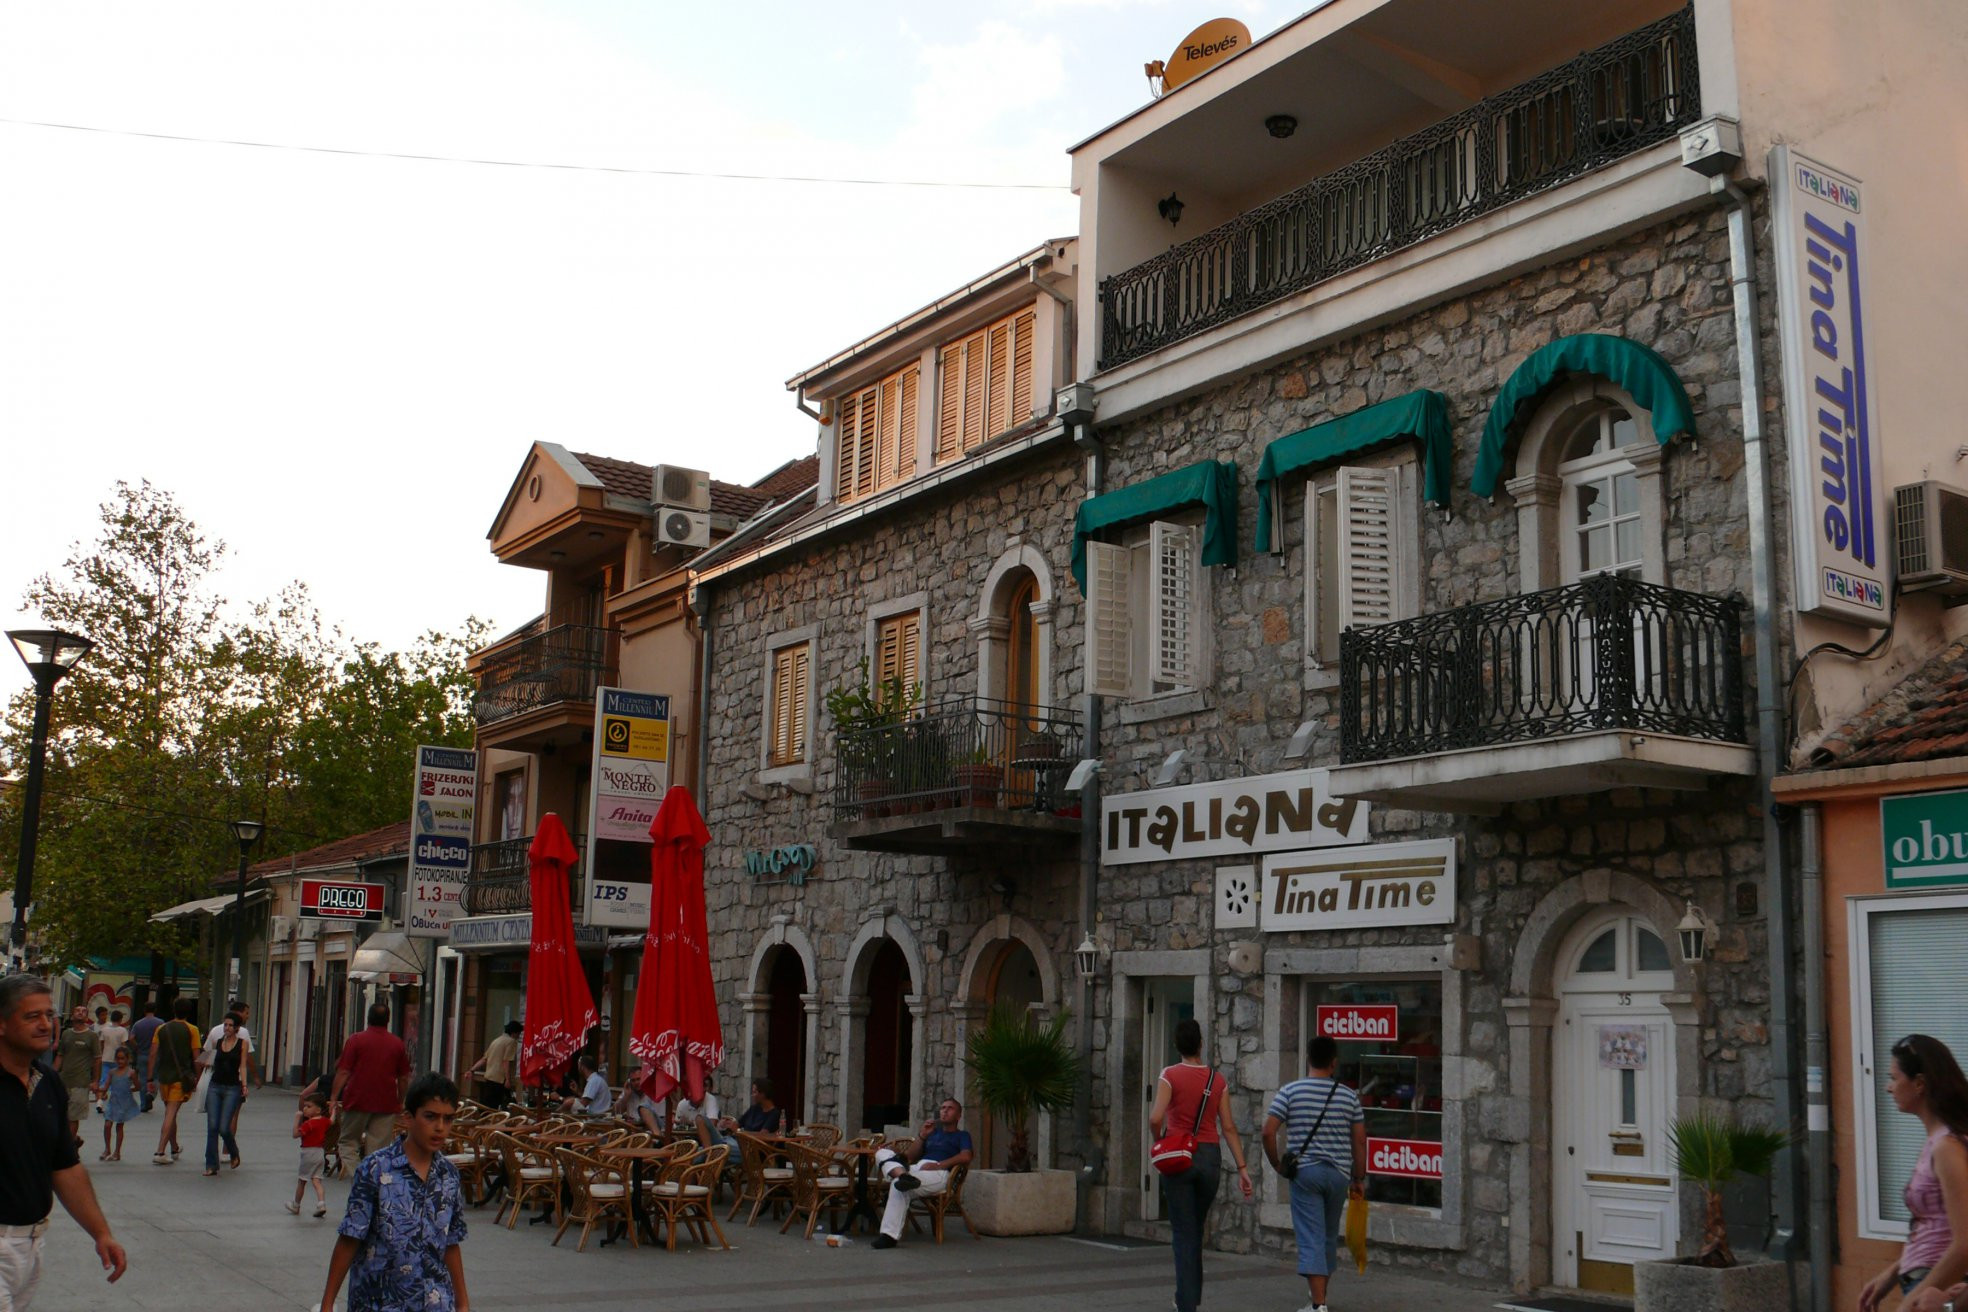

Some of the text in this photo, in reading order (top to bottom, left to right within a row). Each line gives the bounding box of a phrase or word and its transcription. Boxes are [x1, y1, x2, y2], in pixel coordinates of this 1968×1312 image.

[1184, 34, 1238, 61] Televés
[1803, 211, 1857, 362] Tina
[1814, 366, 1860, 556] Time
[421, 771, 475, 785] FRIZERSKI
[604, 771, 652, 785] MONTE
[610, 780, 657, 793] NEGRO
[440, 786, 474, 798] SALON
[608, 806, 653, 823] Anita
[418, 840, 467, 861] chicco
[414, 866, 468, 884] FOTOKOPIRANJE
[321, 888, 365, 908] PREGO
[417, 885, 442, 902] 1.3
[593, 885, 628, 901] IPS
[1271, 866, 1445, 915] Tina Time
[1618, 992, 1632, 1007] 35
[1323, 1011, 1390, 1036] ciciban
[1373, 1145, 1442, 1173] ciciban
